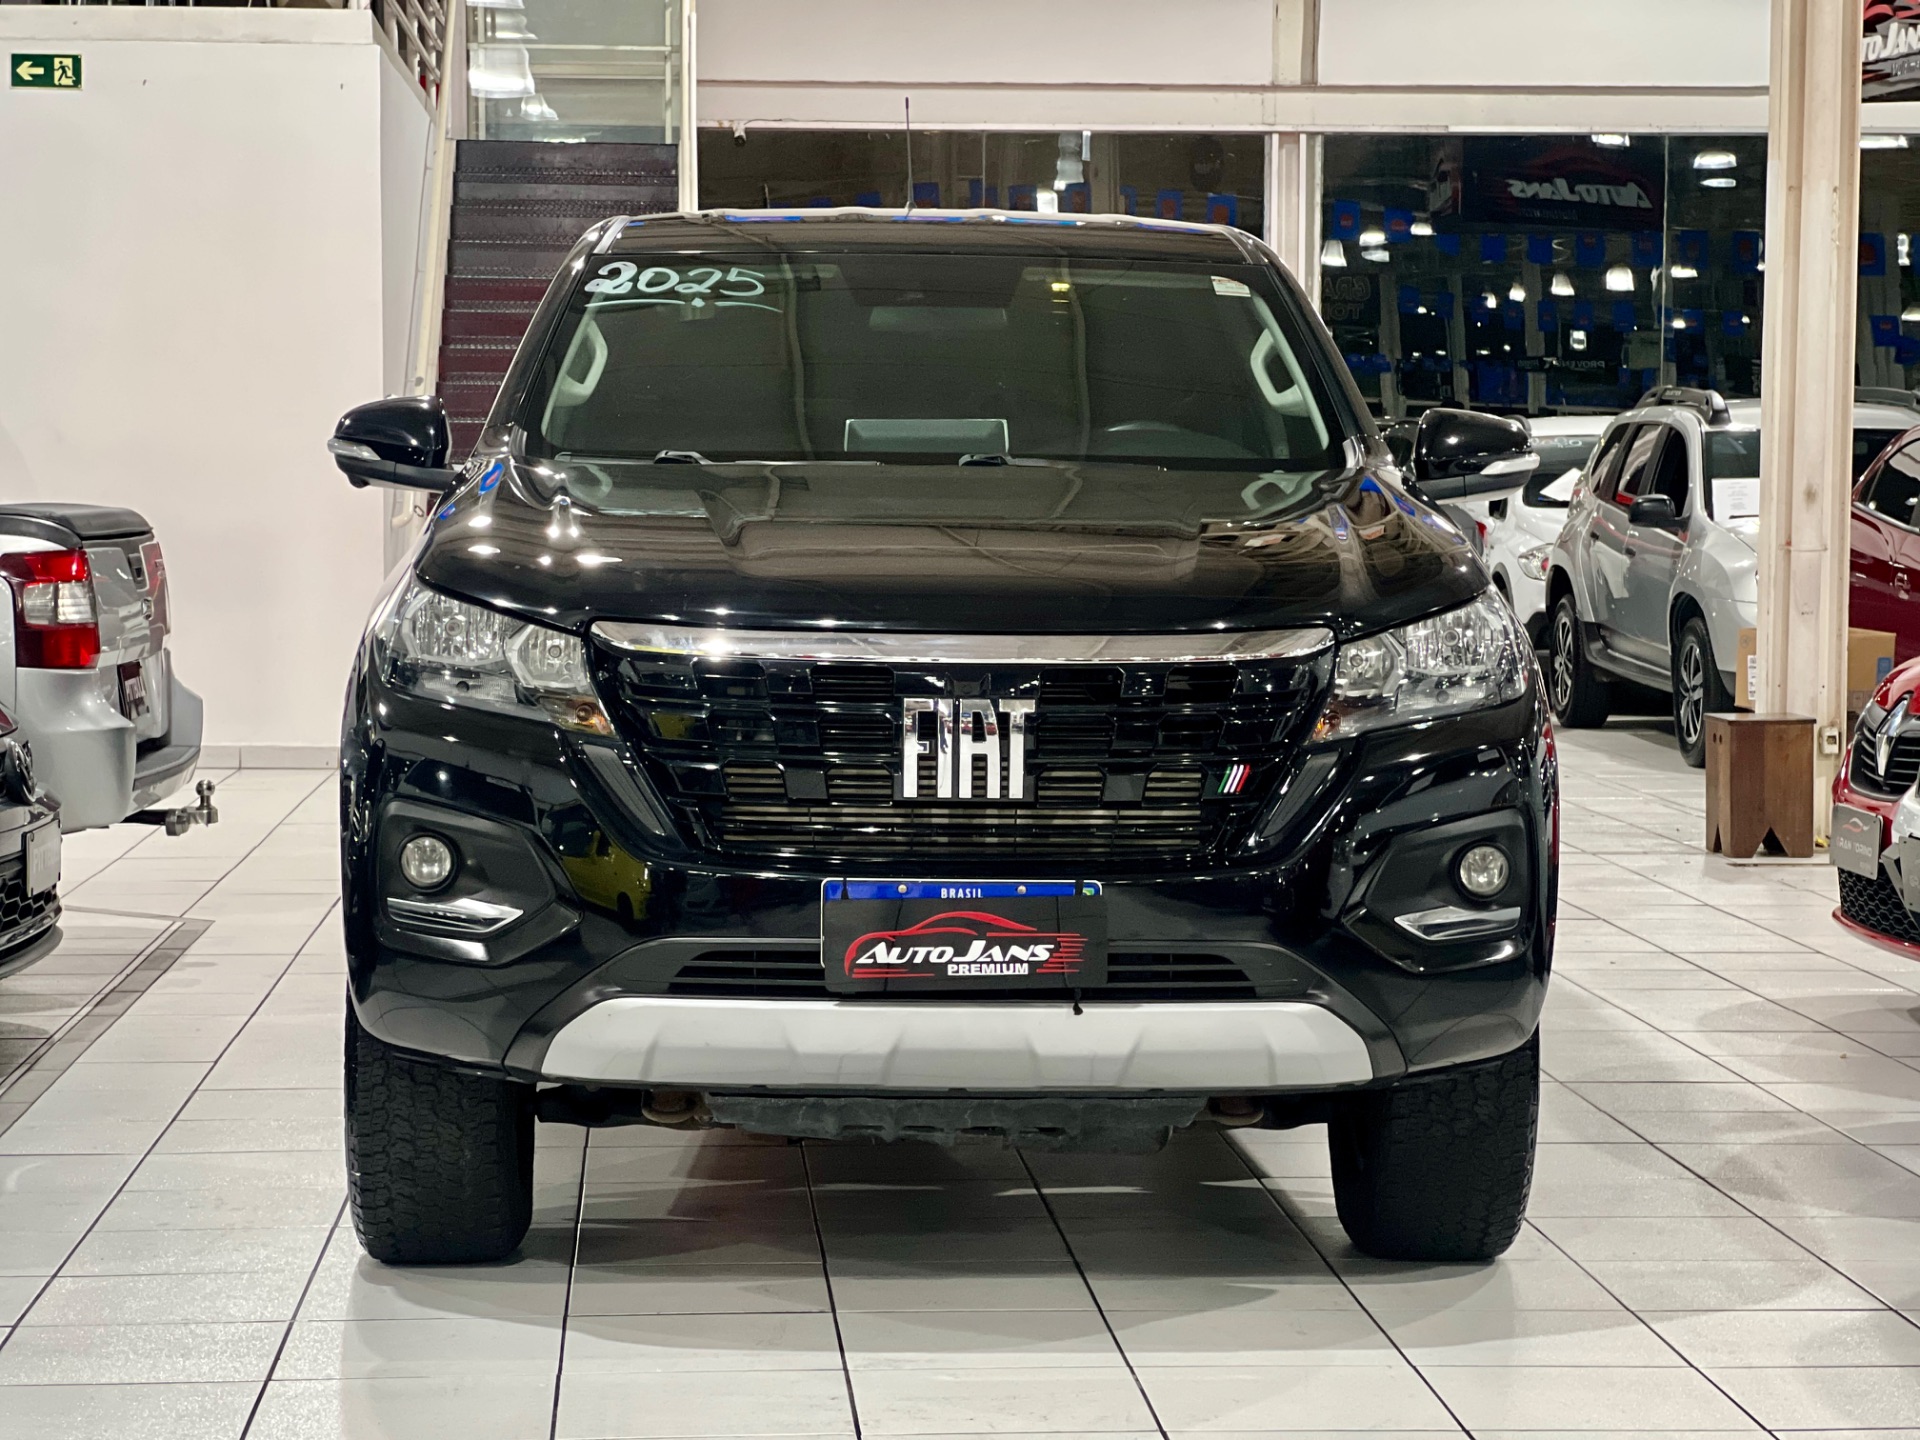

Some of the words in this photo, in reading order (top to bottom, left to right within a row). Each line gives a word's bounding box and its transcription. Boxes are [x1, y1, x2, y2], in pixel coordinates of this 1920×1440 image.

[584, 261, 766, 297] 2025
[903, 697, 1036, 799] FIAT
[941, 888, 983, 899] BRASIL
[856, 941, 951, 964] AUTO
[952, 939, 1055, 962] JANS
[947, 963, 1029, 975] PREMIUM
